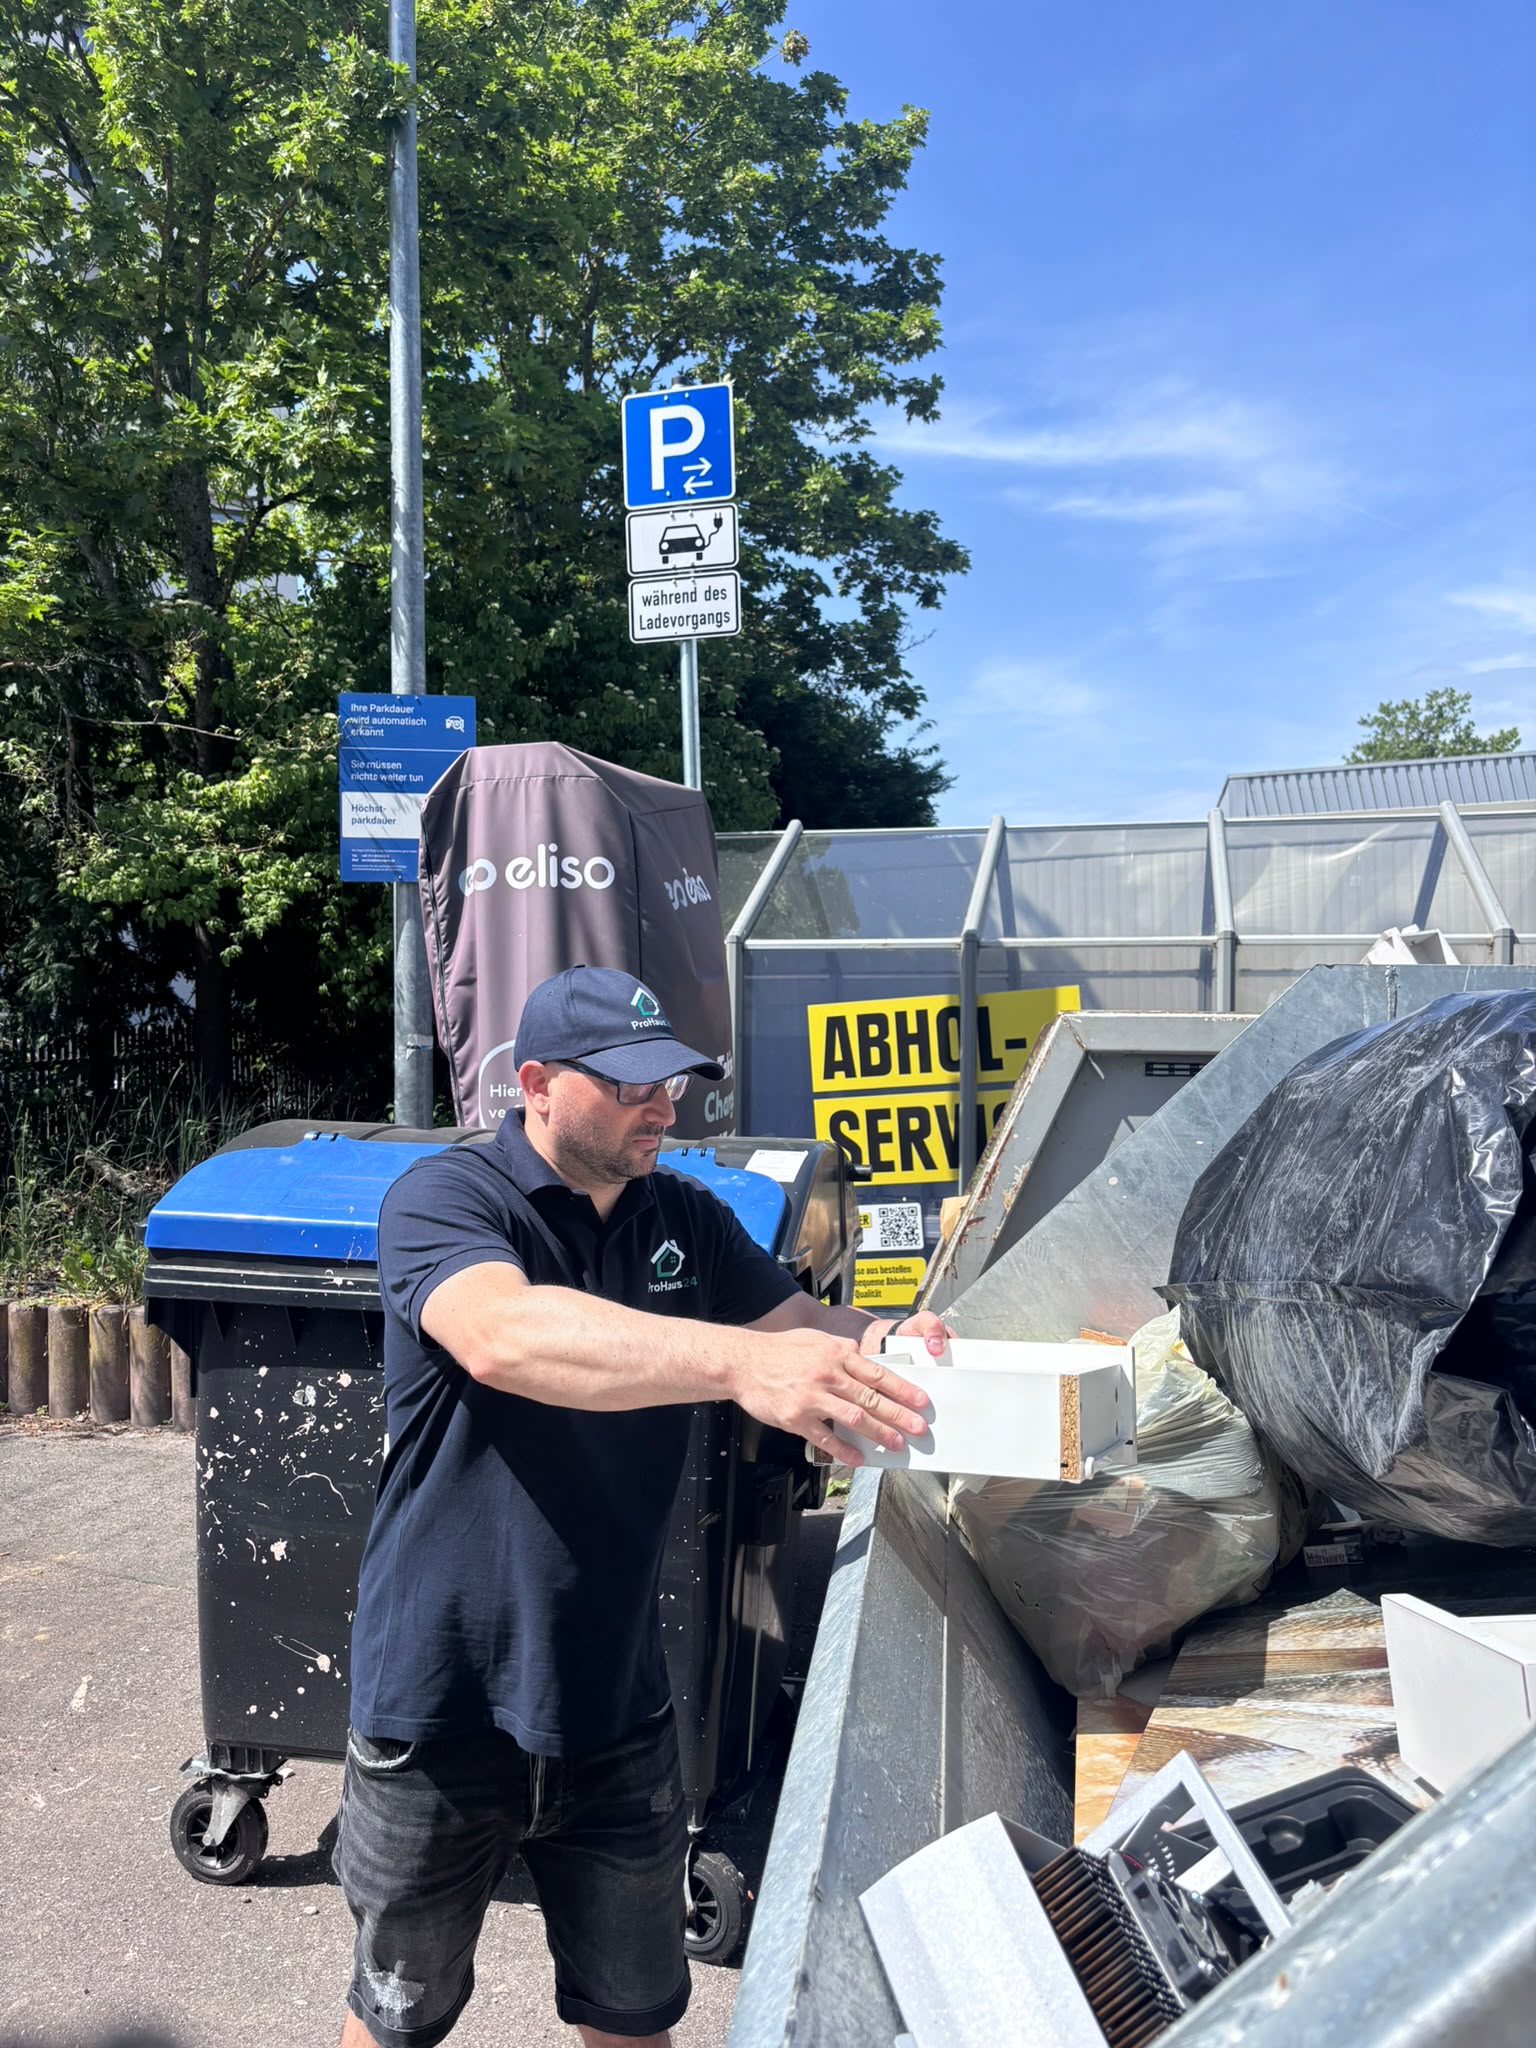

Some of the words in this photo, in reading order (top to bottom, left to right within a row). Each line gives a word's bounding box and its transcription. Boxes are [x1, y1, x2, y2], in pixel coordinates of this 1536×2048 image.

[650, 405, 705, 490] P
[641, 586, 698, 607] während
[704, 585, 728, 602] des
[638, 610, 731, 632] Ladevorgangs
[351, 703, 368, 712] Ihre
[370, 704, 415, 713] Parkdauer
[351, 715, 370, 724] wird
[371, 716, 427, 726] automatisch
[350, 728, 384, 736] erkannt
[351, 760, 365, 768] Sie
[367, 760, 402, 769] müssen
[351, 772, 378, 780] nichts
[380, 773, 407, 781] weiter
[409, 774, 424, 782] tun
[351, 804, 387, 813] Höchst-
[351, 816, 397, 826] parkdauer
[504, 843, 616, 890] eliso
[490, 1084, 522, 1098] Hier
[879, 1264, 912, 1274] bestellen
[886, 1277, 918, 1287] Abholung
[855, 1289, 882, 1298] Qualität
